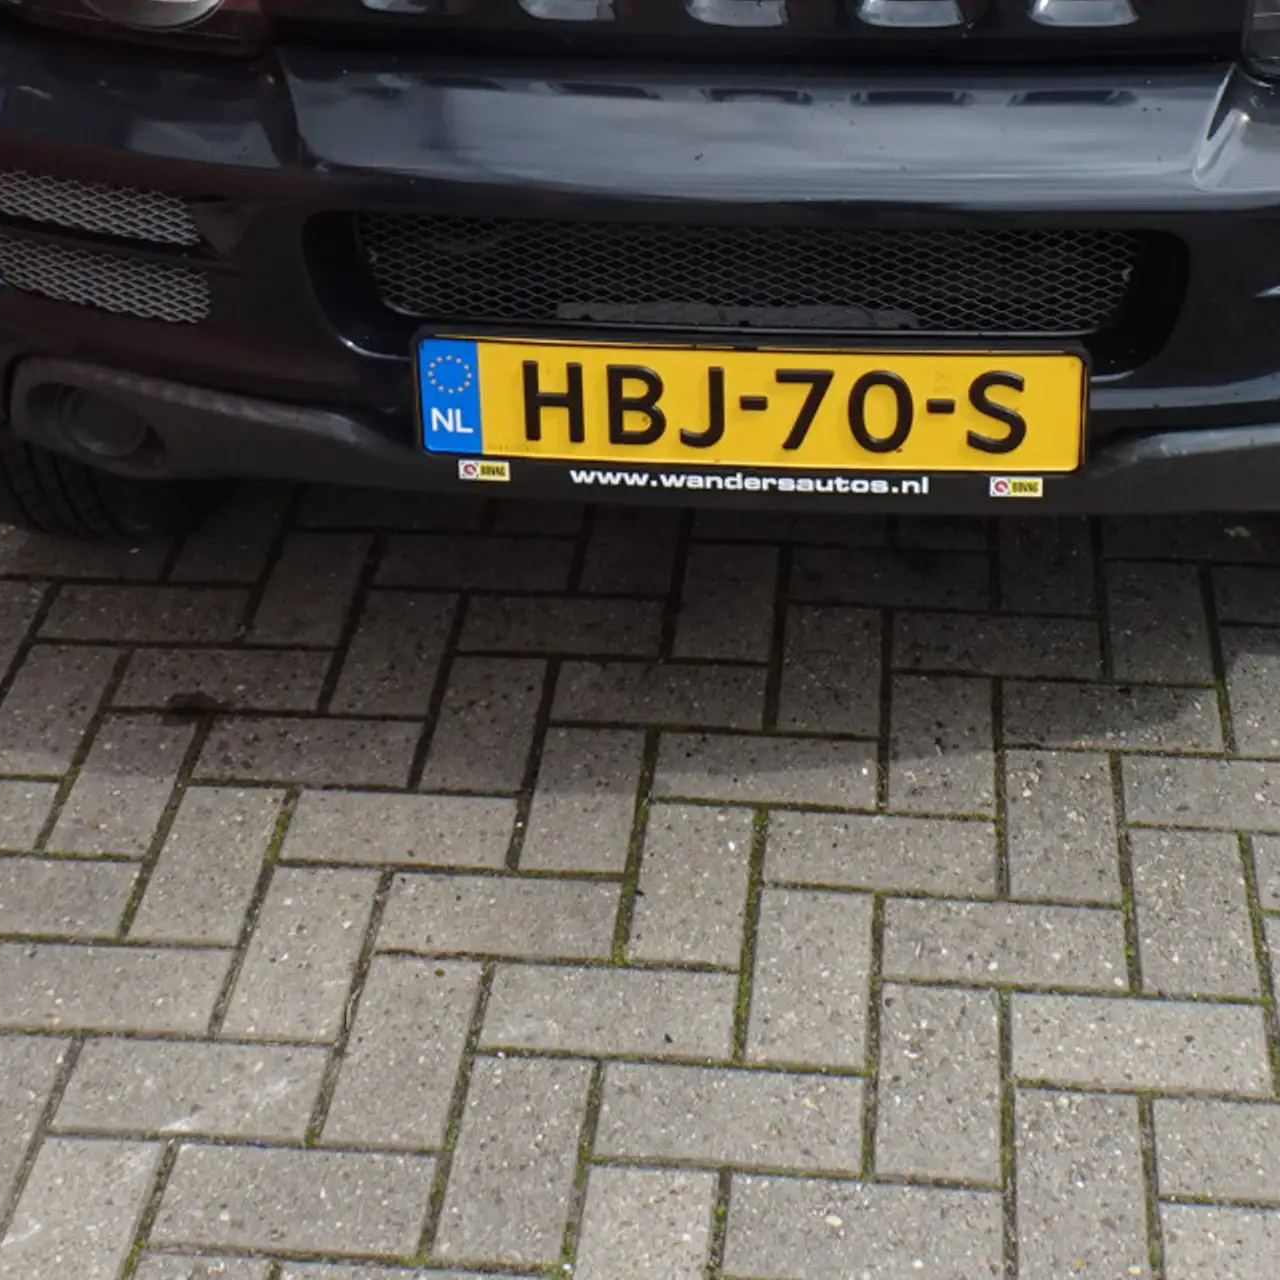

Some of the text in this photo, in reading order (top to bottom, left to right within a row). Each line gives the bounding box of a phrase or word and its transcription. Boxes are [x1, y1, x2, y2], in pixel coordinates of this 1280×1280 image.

[430, 407, 473, 433] NL
[522, 360, 1027, 454] HBJ-70-S
[570, 470, 929, 494] www.wandersautos.nl
